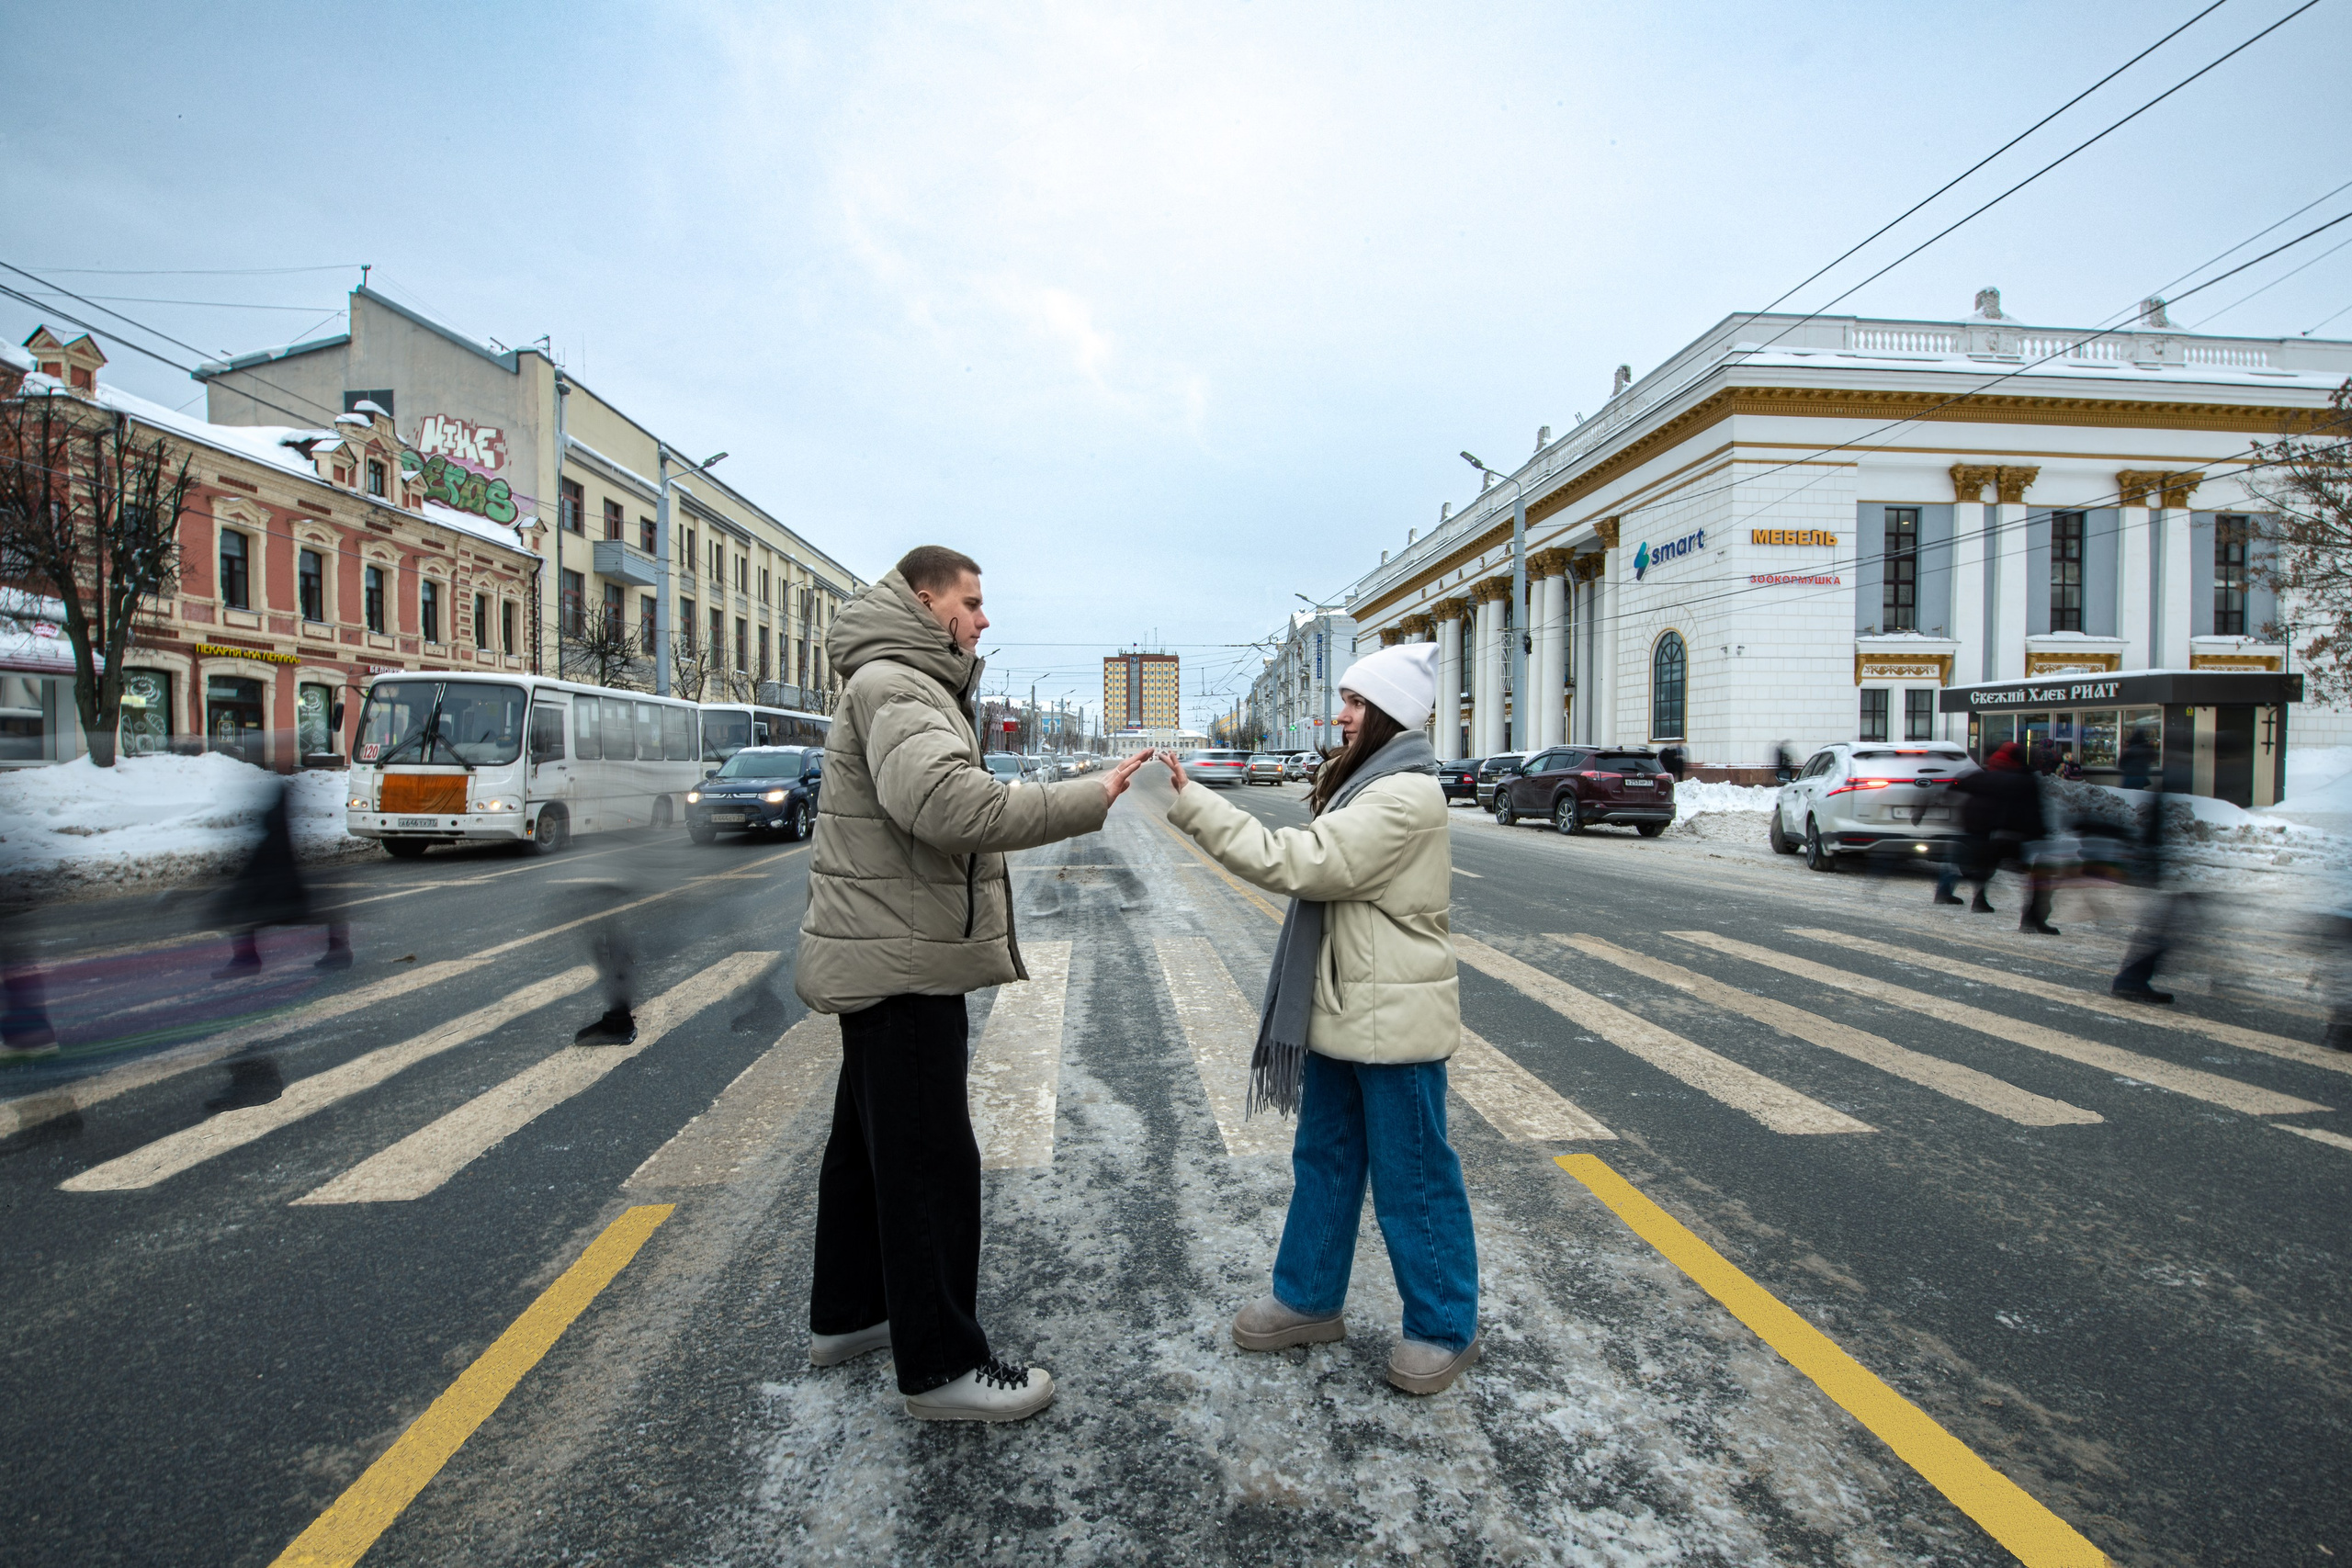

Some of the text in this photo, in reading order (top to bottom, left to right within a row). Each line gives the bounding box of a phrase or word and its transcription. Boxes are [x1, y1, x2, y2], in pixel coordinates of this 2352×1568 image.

[1752, 529, 1838, 546] МЕБЕЛЬ
[1652, 527, 1704, 565] smart
[1750, 575, 1841, 585] ЗООКОРМУШКА
[196, 643, 242, 658] ПЕКАРНЯ
[2070, 682, 2120, 699] РИАТ
[364, 745, 379, 759] 120
